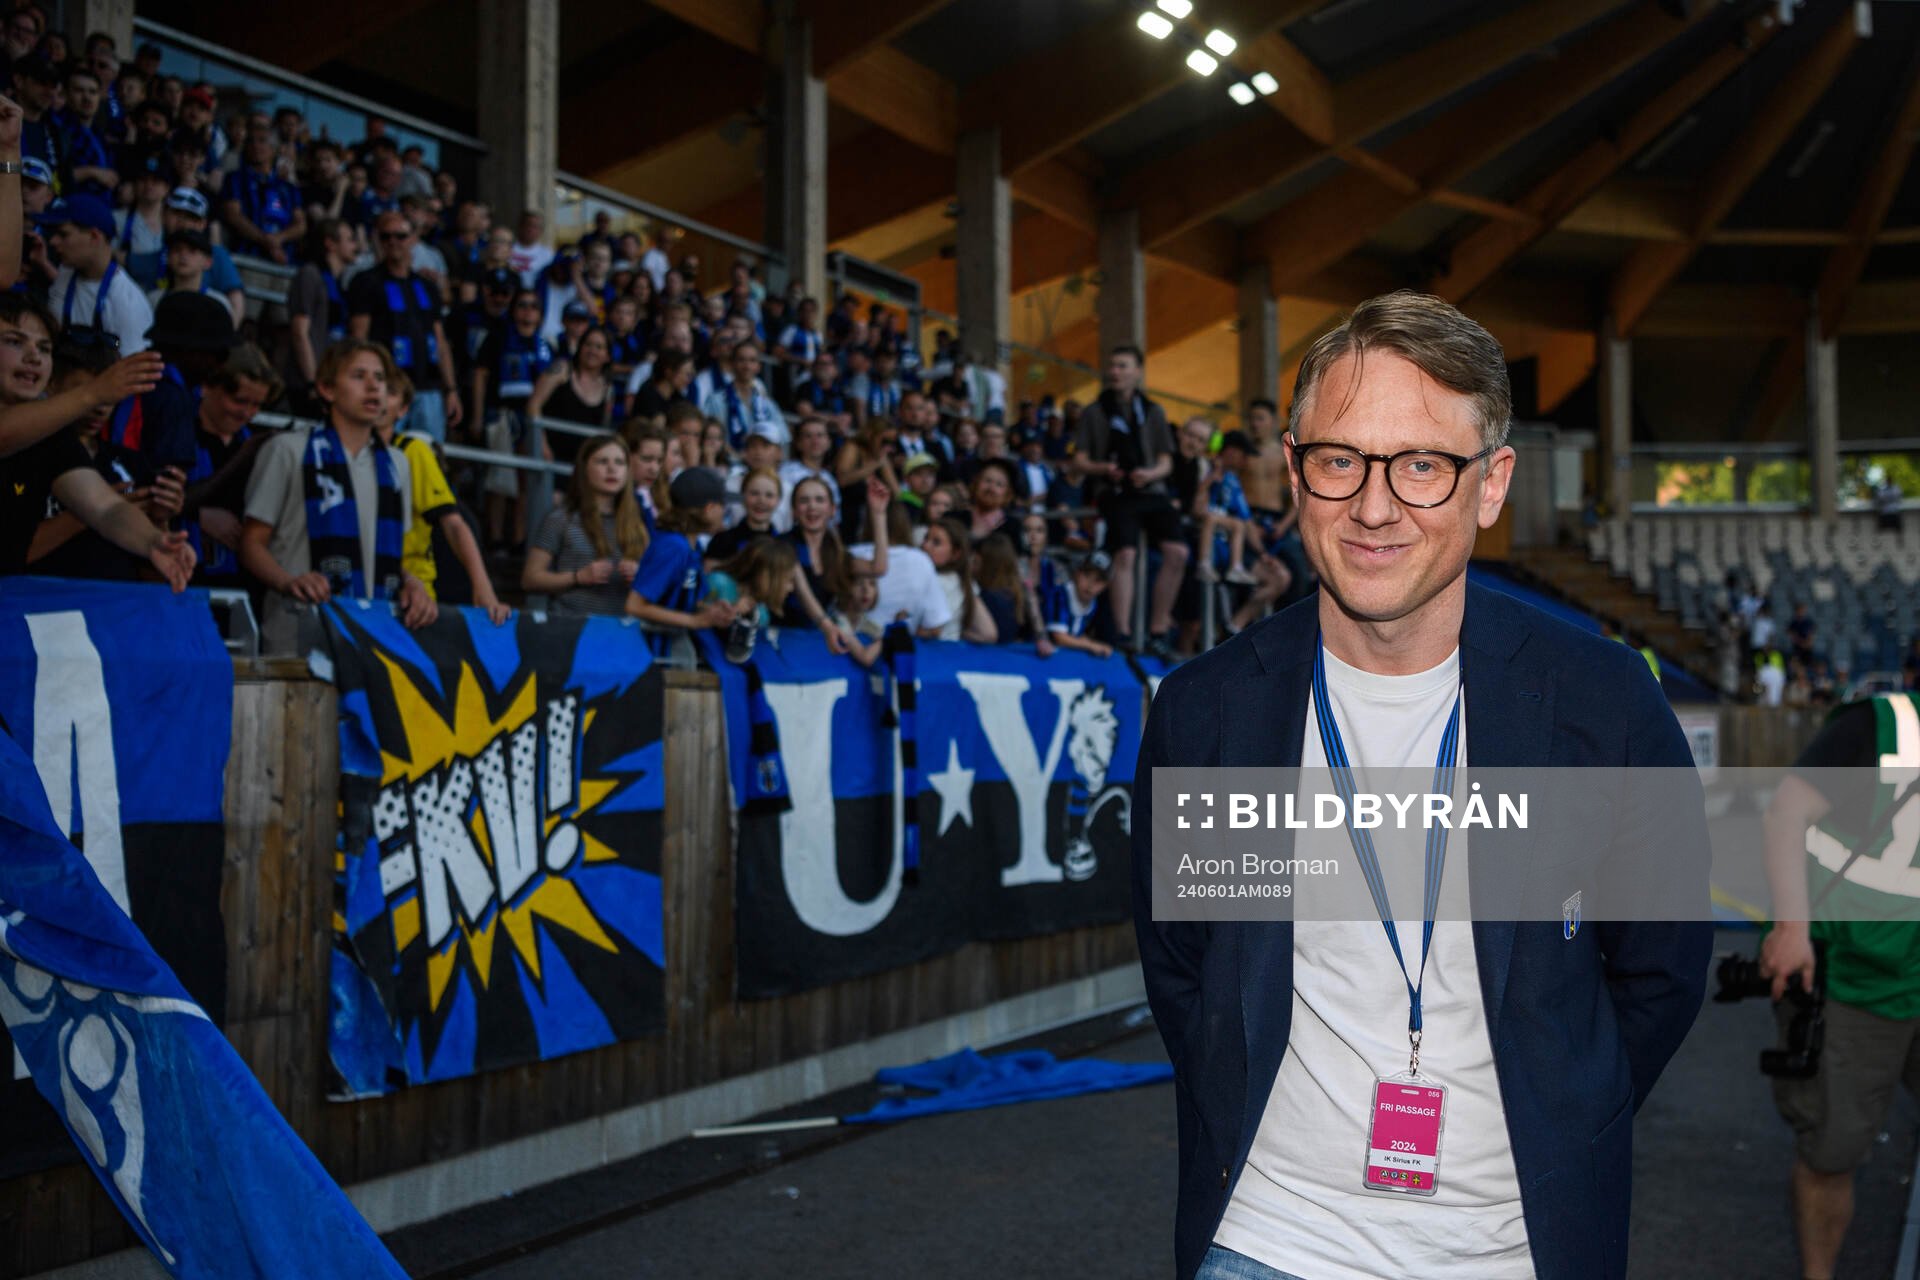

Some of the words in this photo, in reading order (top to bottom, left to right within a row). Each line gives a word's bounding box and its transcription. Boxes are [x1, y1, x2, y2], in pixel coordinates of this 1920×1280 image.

[1380, 1102, 1394, 1111] FRI
[1395, 1104, 1436, 1116] PASSAGE
[1390, 1140, 1416, 1151] 2024
